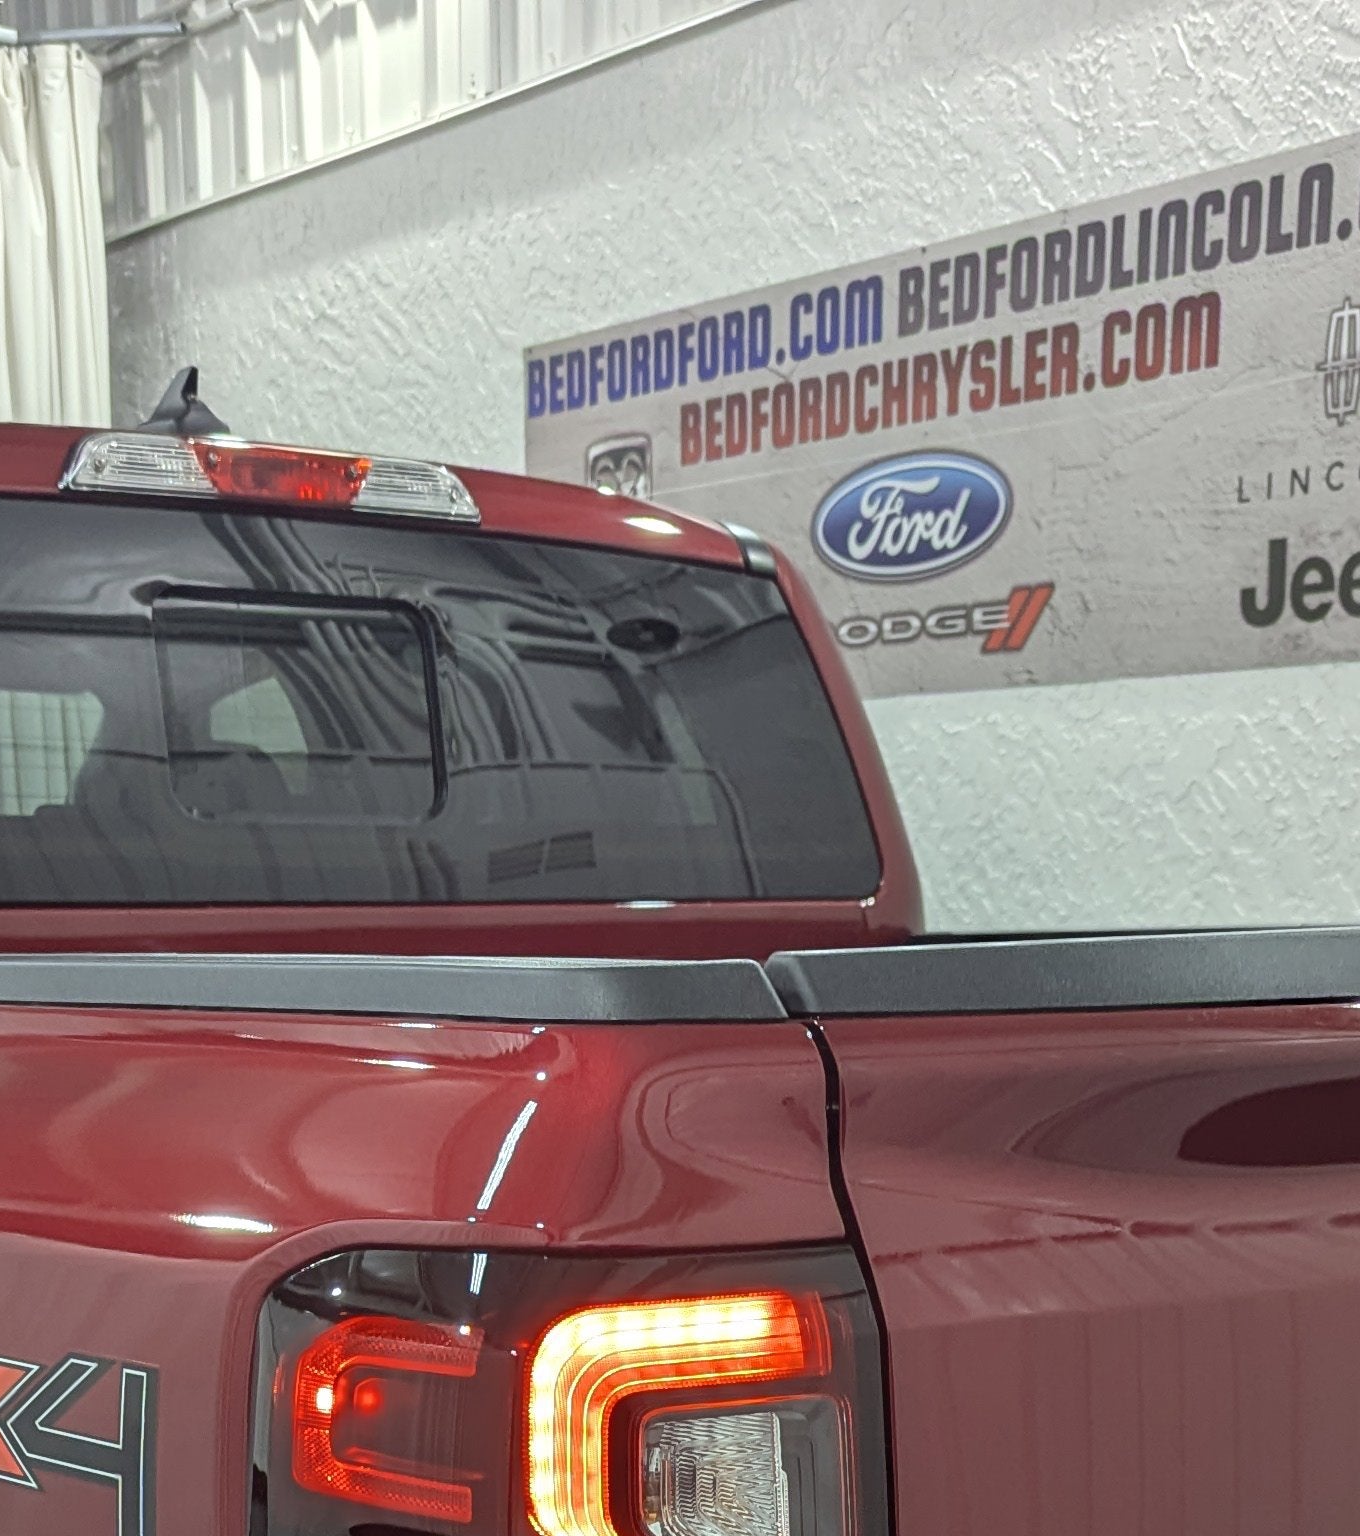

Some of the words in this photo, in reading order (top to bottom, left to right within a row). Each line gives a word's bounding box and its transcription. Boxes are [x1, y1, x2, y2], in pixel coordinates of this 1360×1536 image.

[528, 275, 883, 418] BEDFORDFORD.COM
[680, 292, 1221, 466] BEDFORDCHRYSLER.COM
[847, 475, 972, 560] Ford
[836, 600, 1012, 648] ODGE
